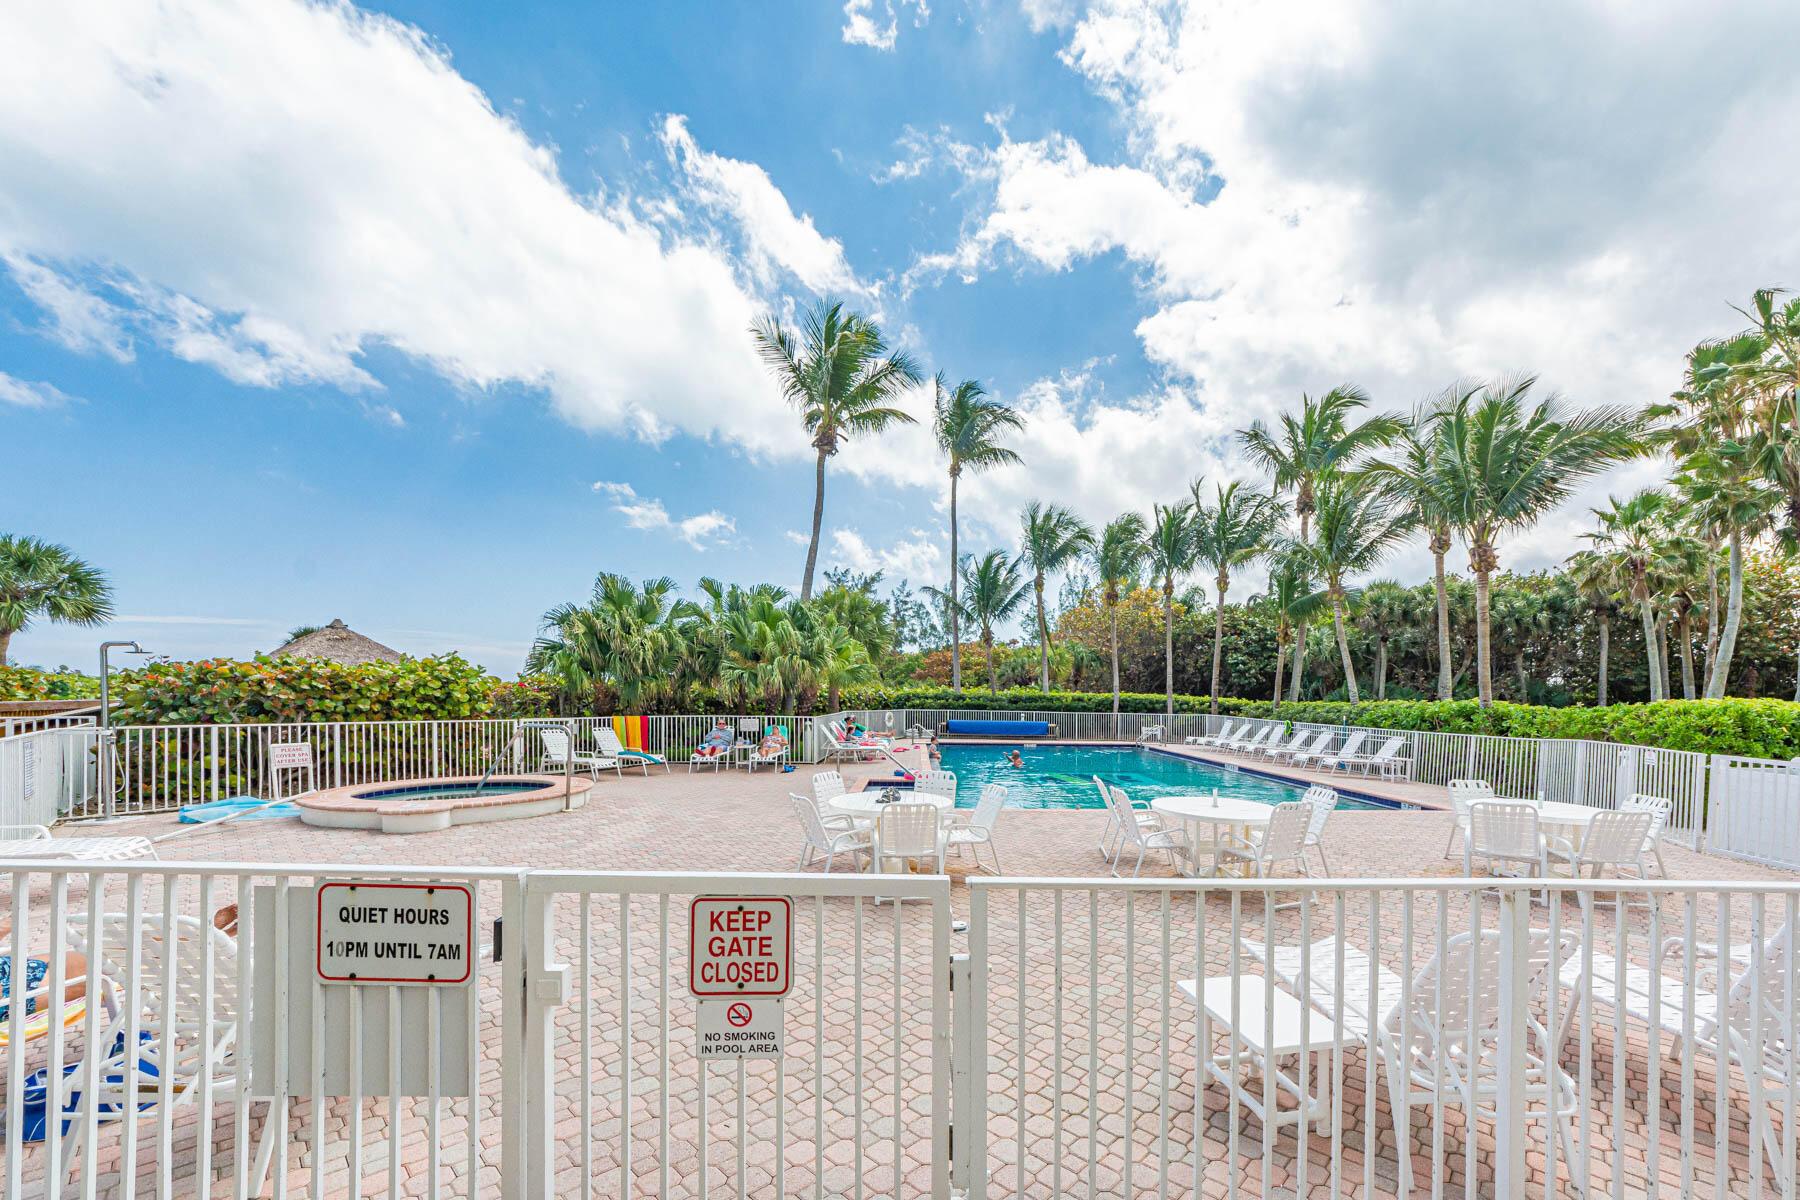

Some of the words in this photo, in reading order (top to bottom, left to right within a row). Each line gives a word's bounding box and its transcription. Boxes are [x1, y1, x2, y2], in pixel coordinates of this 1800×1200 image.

[339, 906, 388, 924] QUIET
[394, 908, 450, 926] HOURS
[710, 910, 772, 932] KEEP
[326, 941, 369, 958] 10PM
[374, 942, 422, 959] UNTIL
[428, 944, 461, 960] 7AM
[708, 936, 773, 957] GATE
[701, 961, 779, 983] CLOSED
[704, 1032, 721, 1042] NO
[724, 1031, 776, 1041] SMOKING
[701, 1045, 712, 1054] IN
[715, 1044, 746, 1054] POOL
[748, 1043, 779, 1053] AREA
